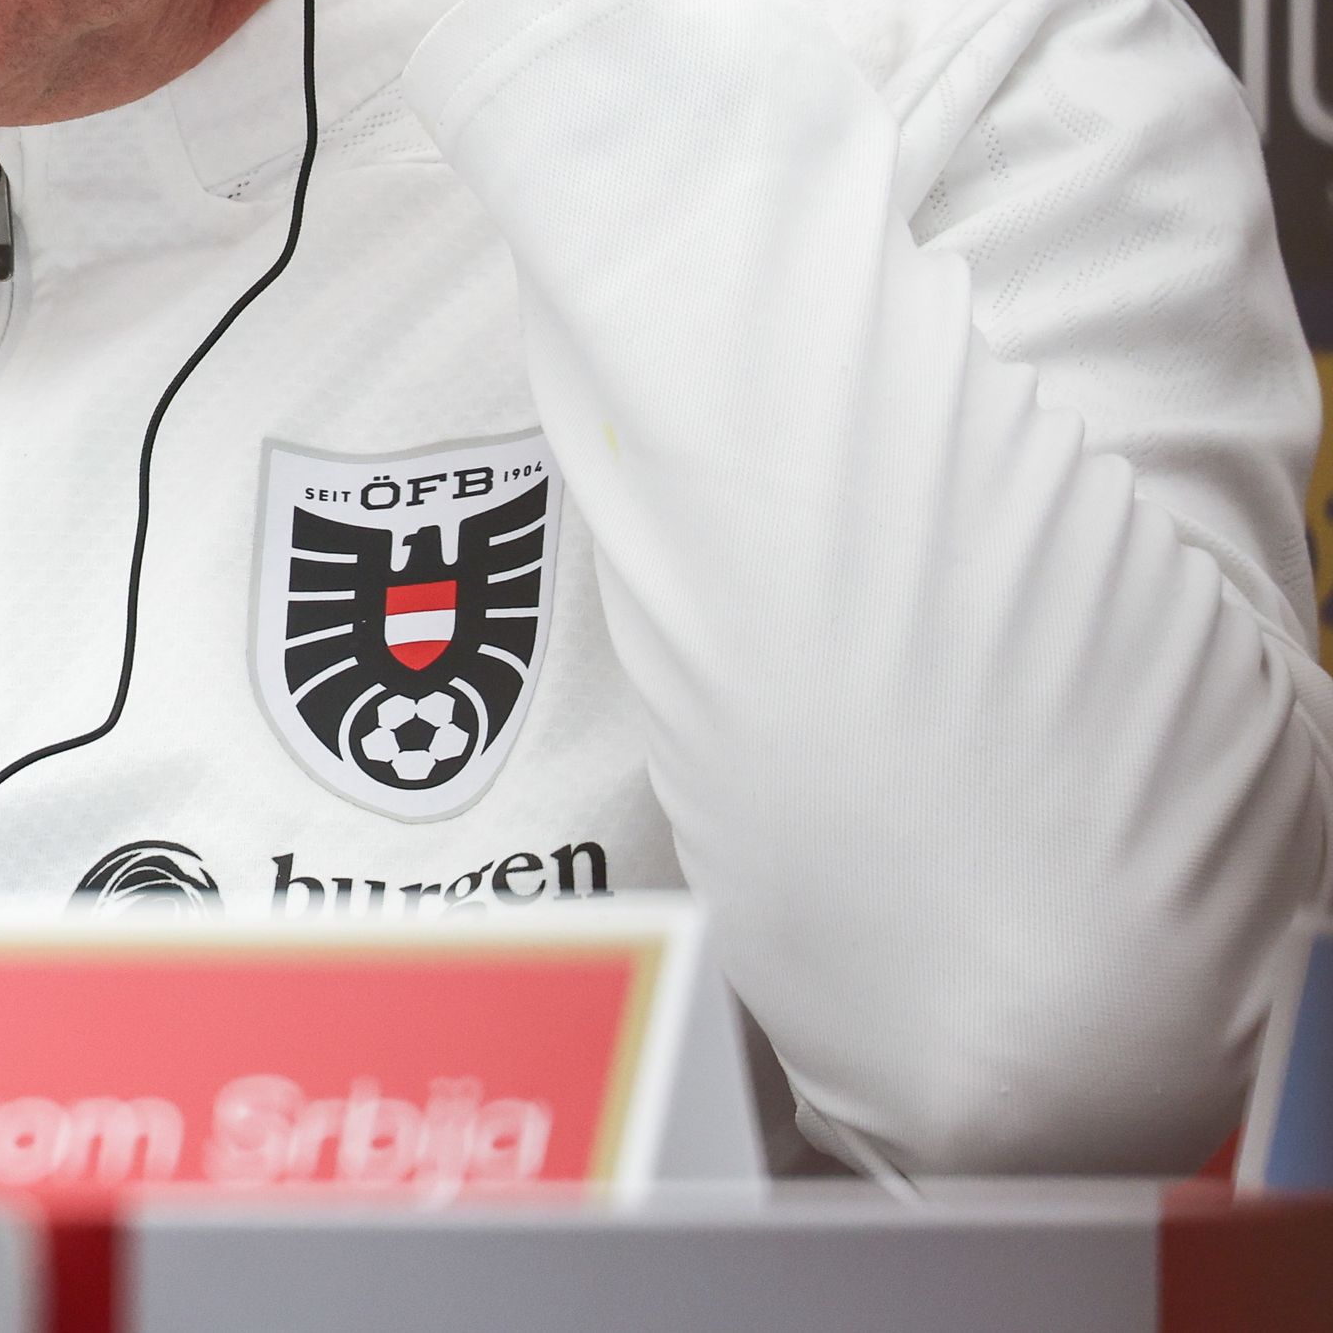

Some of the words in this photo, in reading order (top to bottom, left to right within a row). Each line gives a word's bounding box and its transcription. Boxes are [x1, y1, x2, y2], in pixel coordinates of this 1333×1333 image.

[304, 486, 352, 503] SEIT
[360, 466, 494, 511] ÖFB
[503, 460, 543, 483] 1904
[202, 1072, 553, 1212] Srbija
